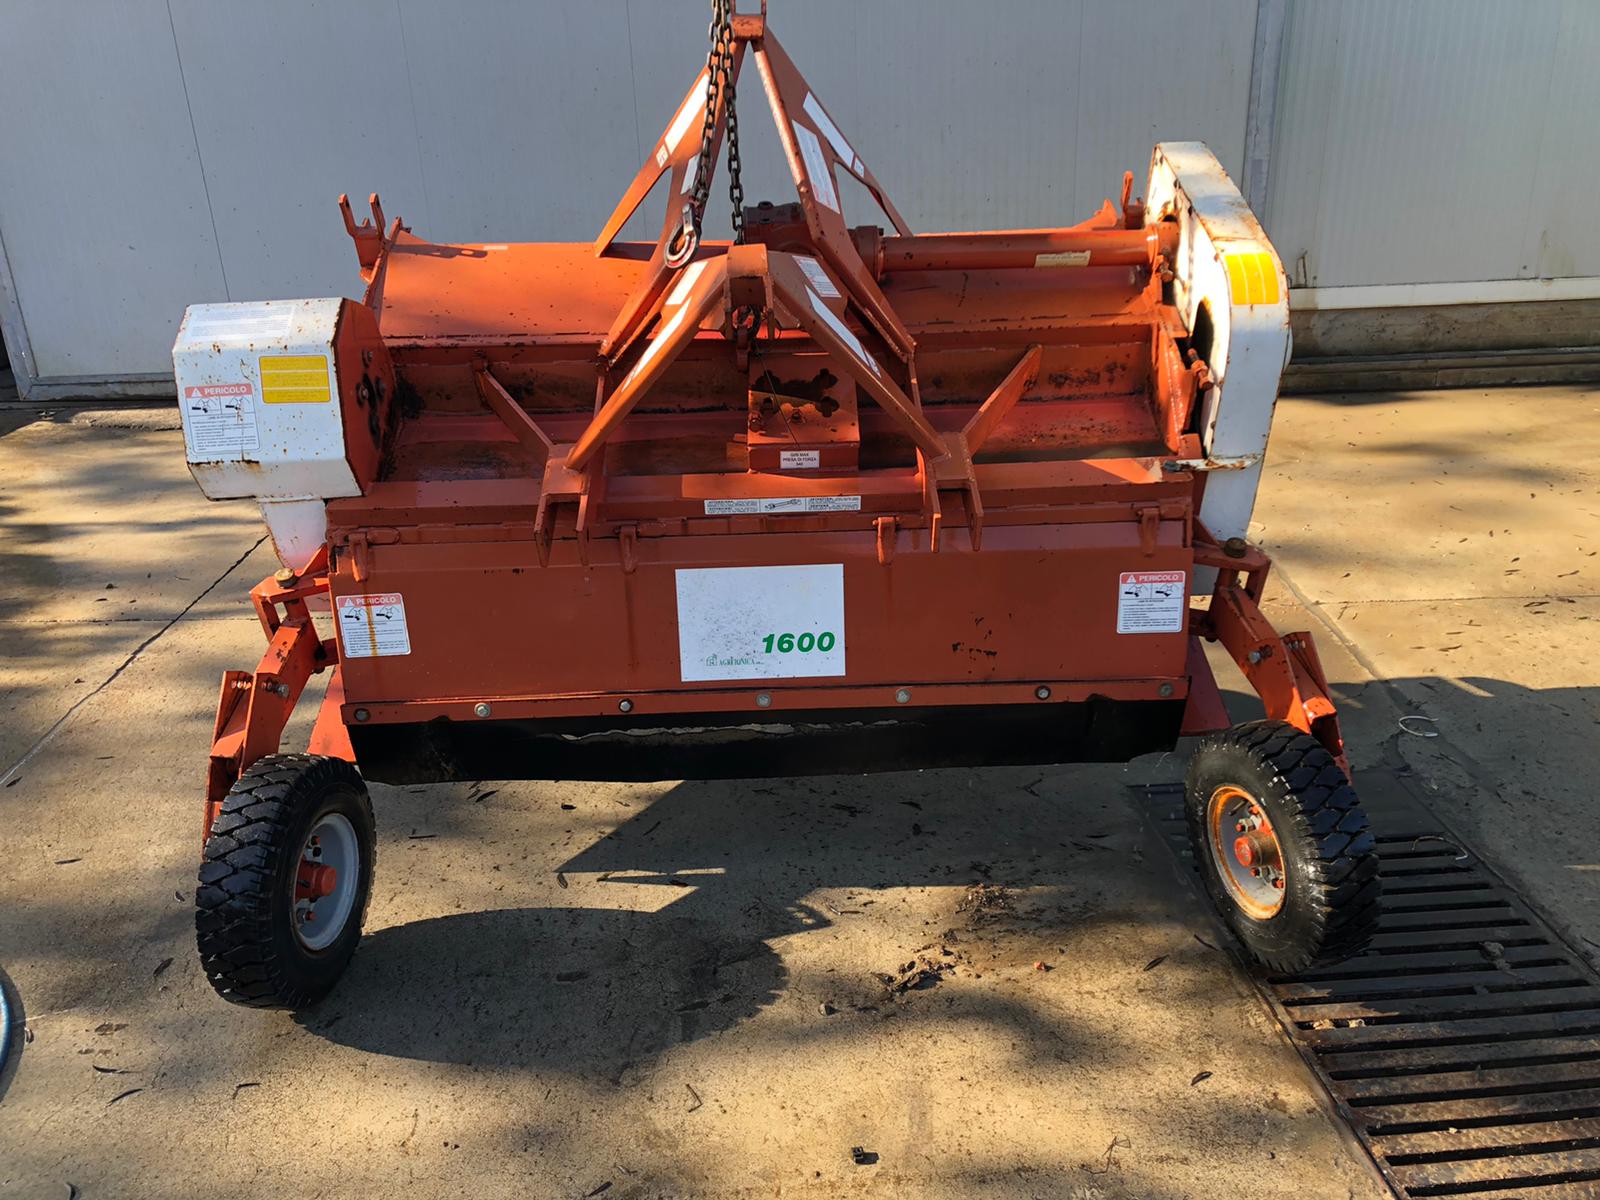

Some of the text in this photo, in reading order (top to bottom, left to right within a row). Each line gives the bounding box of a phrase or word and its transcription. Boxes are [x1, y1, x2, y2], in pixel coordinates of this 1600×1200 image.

[204, 386, 247, 395] PERICOLO
[356, 596, 397, 605] PERICOLO
[762, 632, 835, 653] 1600
